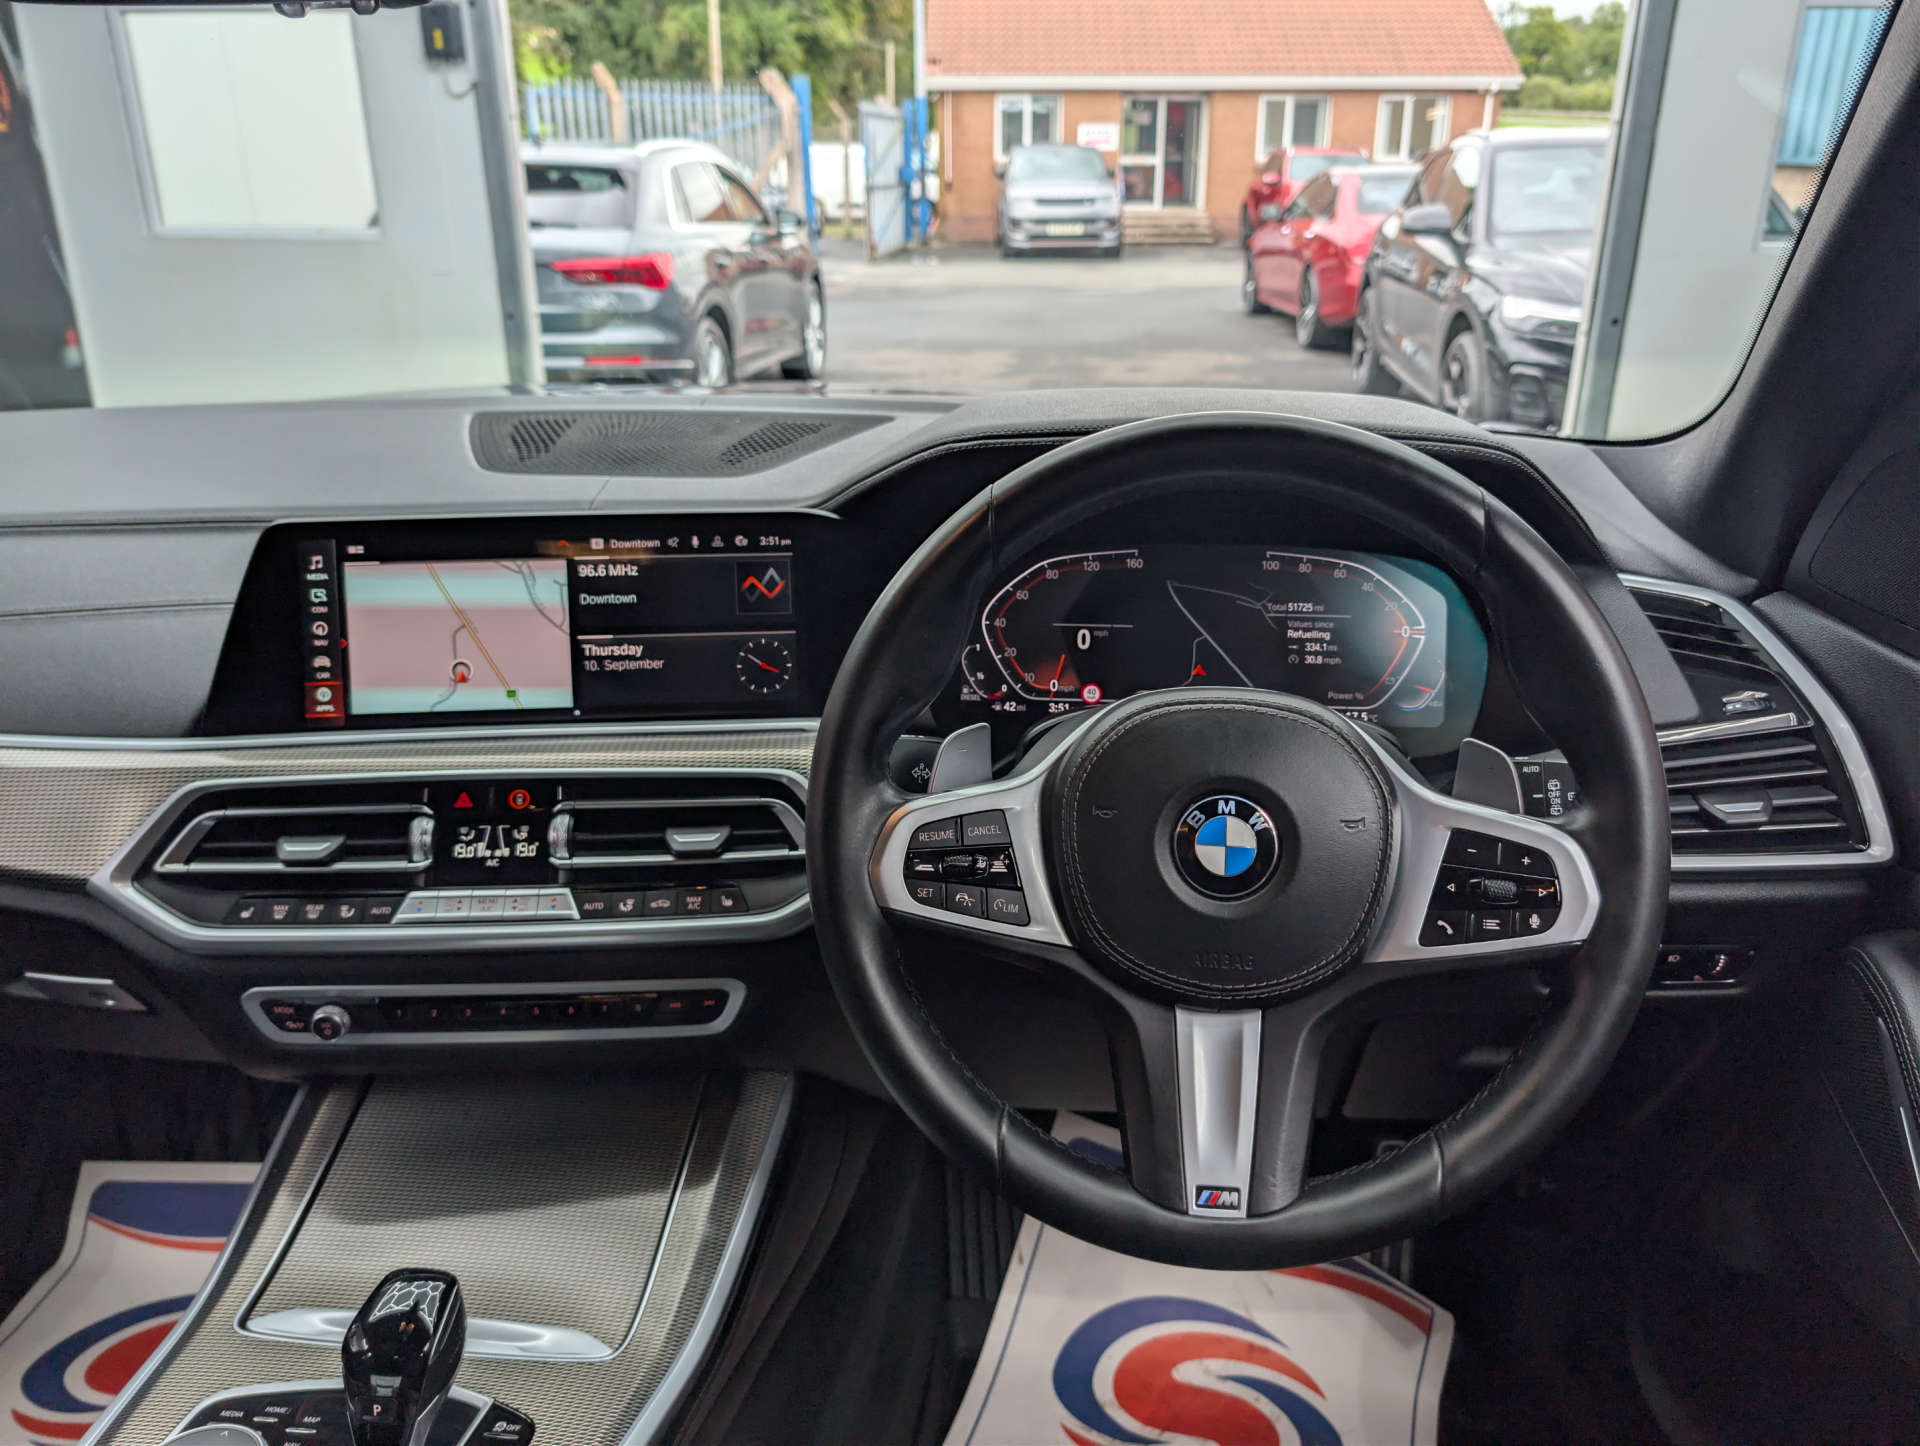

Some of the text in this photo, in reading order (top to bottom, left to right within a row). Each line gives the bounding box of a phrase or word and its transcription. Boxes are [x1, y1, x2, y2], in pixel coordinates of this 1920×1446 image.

[610, 538, 661, 549] Downtown
[759, 536, 779, 546] 3:51
[1083, 561, 1100, 572] 120
[1125, 558, 1144, 569] 160
[1262, 560, 1280, 571] 100
[1298, 562, 1312, 573] 80
[577, 563, 639, 577] 96.6 MHz
[1046, 569, 1059, 580] 80
[1333, 569, 1346, 579] 60
[1361, 582, 1374, 592] 40
[579, 593, 638, 605] Downtown
[1016, 590, 1029, 600] 60
[1267, 602, 1287, 611] Total
[1287, 602, 1313, 612] 51725
[1384, 601, 1398, 611] 20
[994, 618, 1007, 628] 40
[1287, 620, 1335, 629] Values since
[1287, 629, 1331, 640] Refuelling
[1401, 625, 1410, 638] 0
[1076, 628, 1091, 651] 0
[581, 643, 643, 658] Thursday
[1004, 647, 1017, 657] 20
[1304, 642, 1327, 652] 334.1
[583, 659, 664, 672] 10. September
[1304, 655, 1341, 665] 30.8 mph
[1024, 672, 1035, 683] 10
[1050, 680, 1059, 692] 0
[1086, 688, 1097, 696] 40
[1327, 691, 1353, 700] Power
[1003, 701, 1016, 712] 42
[1048, 702, 1069, 713] 3:51
[1522, 765, 1540, 773] AUTO
[1185, 799, 1271, 832] BMW
[918, 829, 956, 842] RESUME
[967, 825, 1001, 837] CANCEL
[917, 888, 934, 898] SET
[370, 906, 392, 915] AUTO
[583, 902, 604, 910] AUTO
[687, 902, 700, 910] A/C
[1003, 903, 1019, 913] LIM
[1192, 951, 1255, 970] AIRBAG
[219, 1409, 245, 1418] MEDIA
[372, 1403, 382, 1417] P
